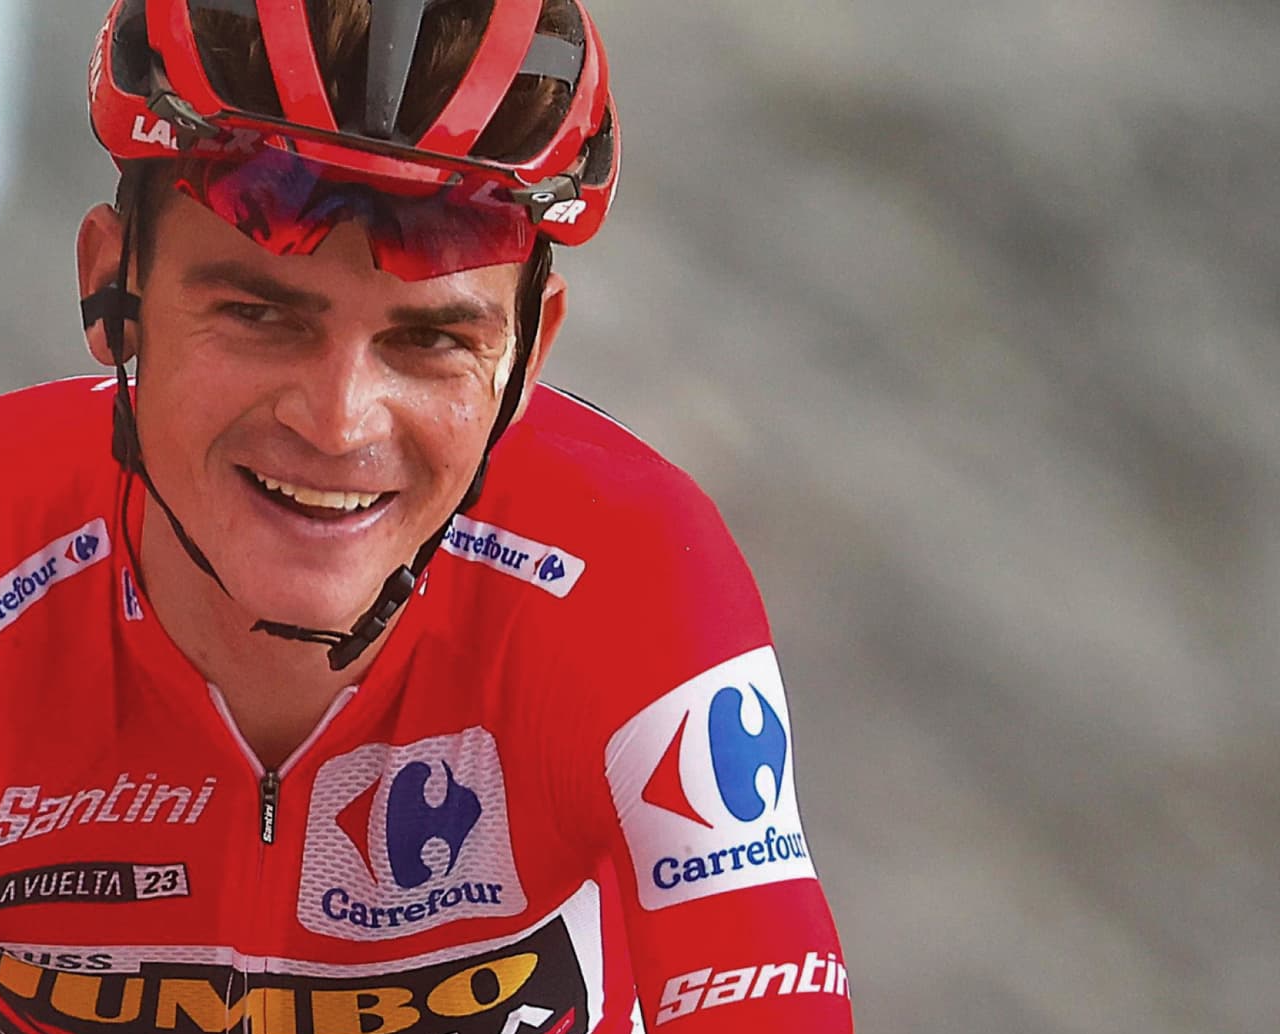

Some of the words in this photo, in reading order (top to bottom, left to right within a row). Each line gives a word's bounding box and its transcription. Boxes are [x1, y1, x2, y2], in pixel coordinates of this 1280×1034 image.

[23, 870, 122, 899] VUELTA
[143, 871, 180, 894] 23
[322, 883, 502, 928] Carrefour
[655, 952, 851, 1027] Santin
